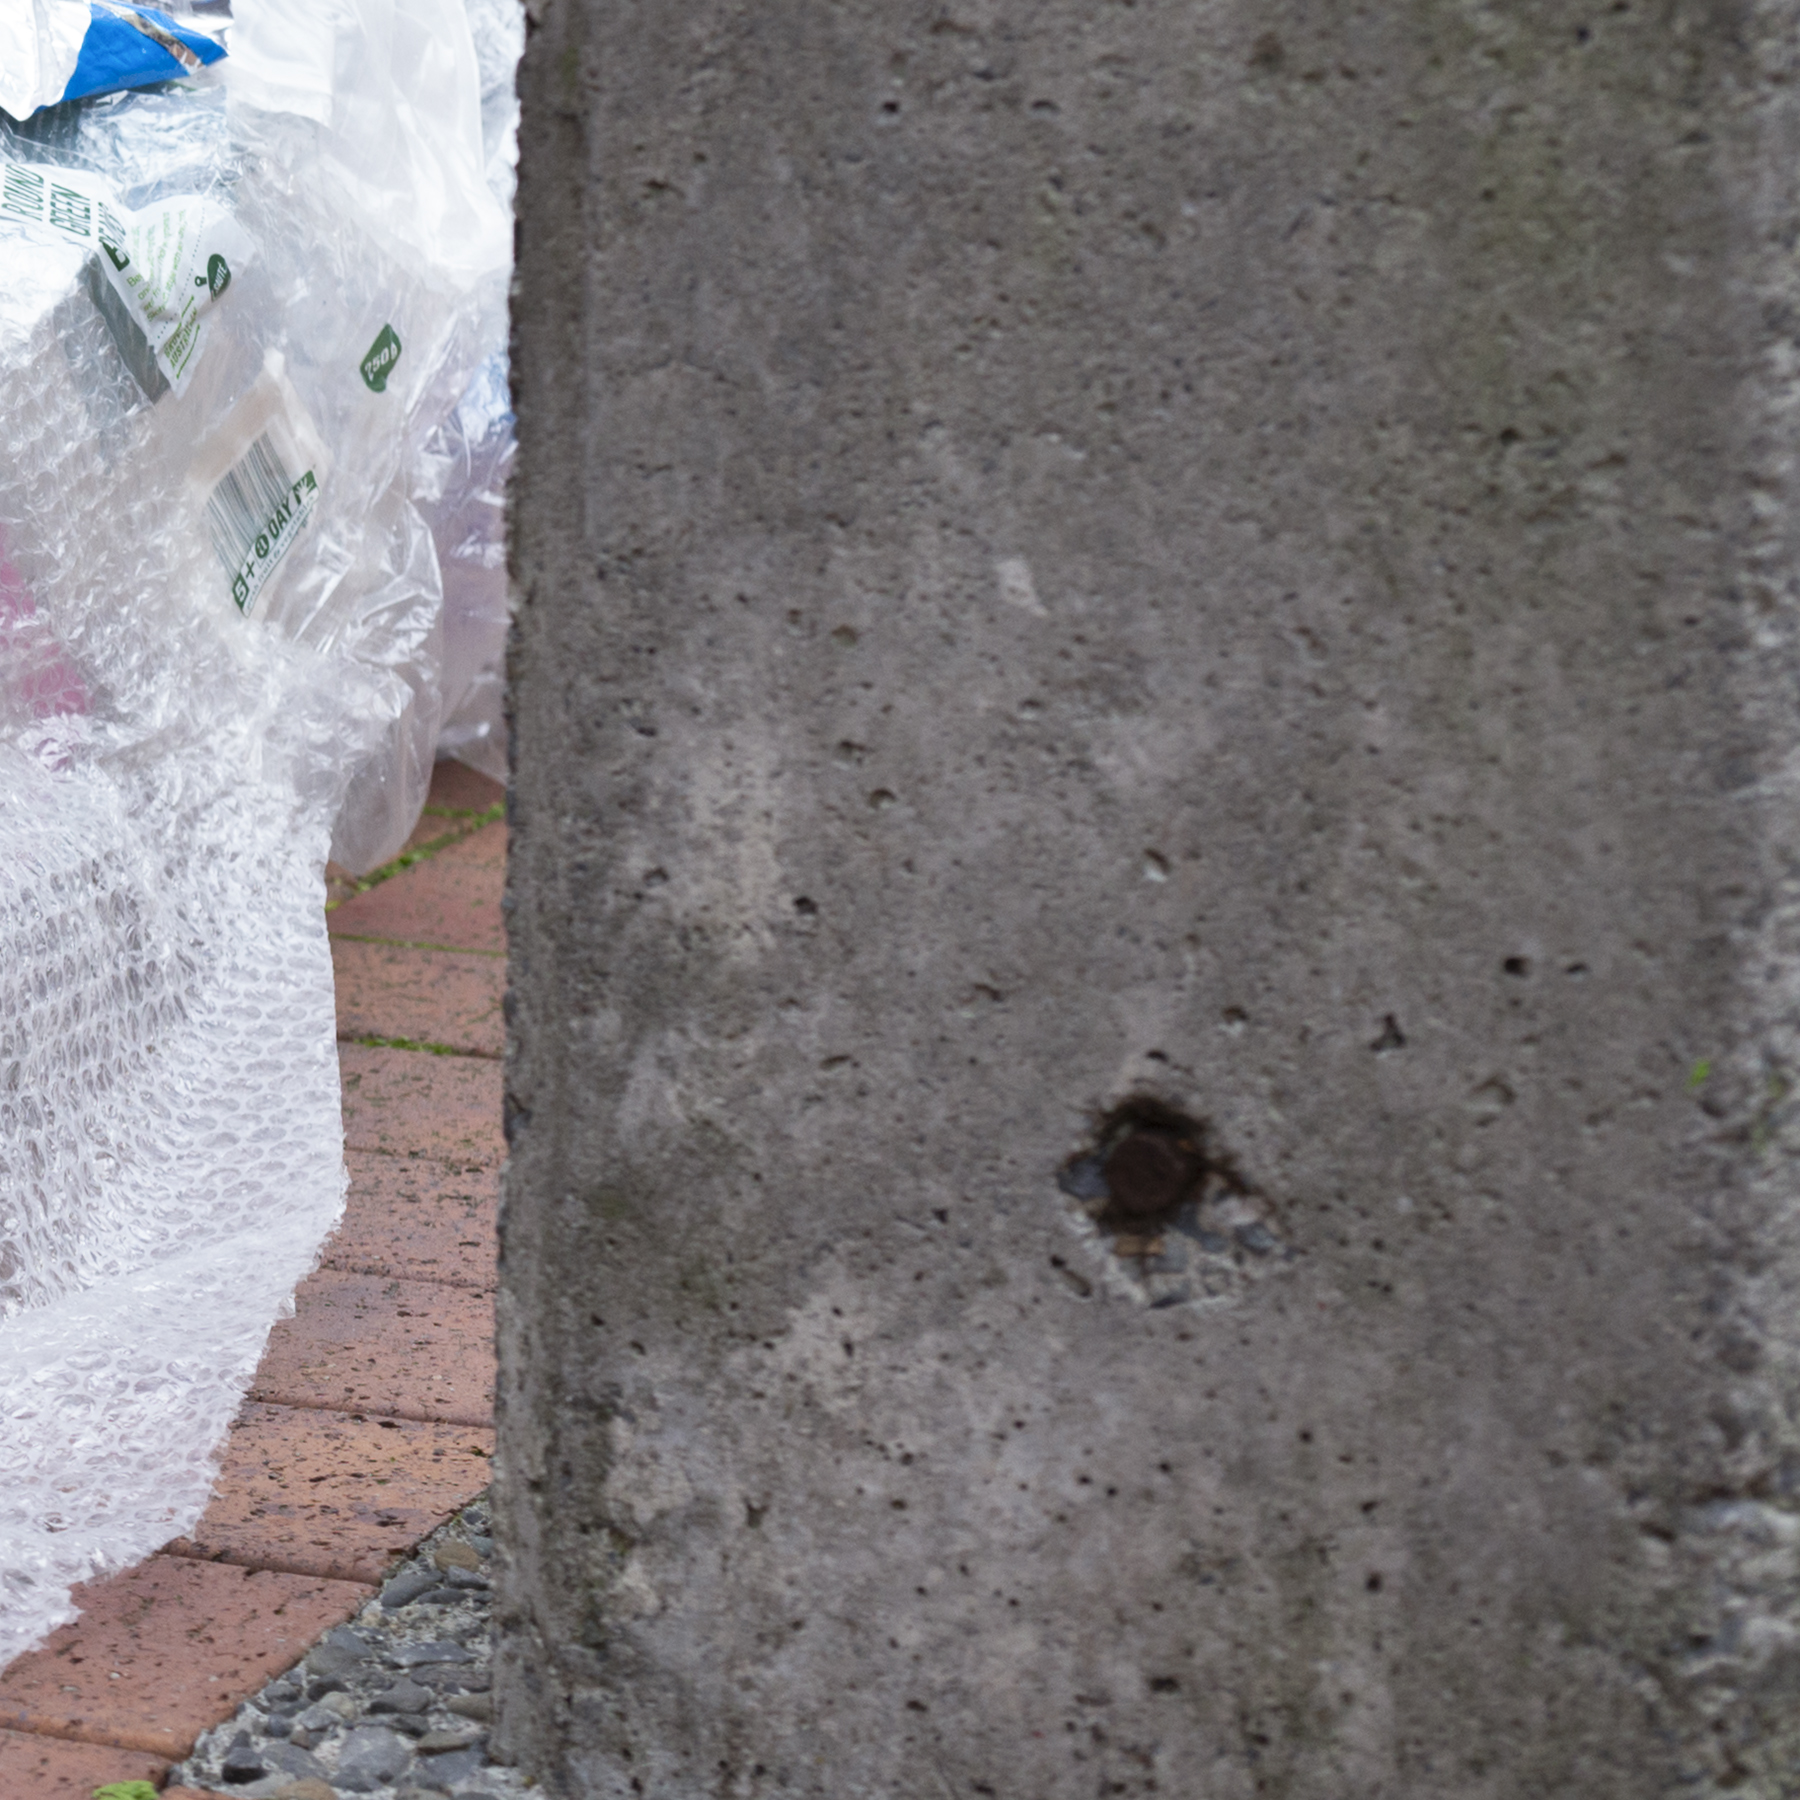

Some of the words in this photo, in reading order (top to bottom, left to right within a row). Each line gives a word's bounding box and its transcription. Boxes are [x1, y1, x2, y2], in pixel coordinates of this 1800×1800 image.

[49, 182, 90, 238] GREEN
[362, 340, 400, 382] 250g
[265, 498, 296, 540] DAY
[254, 557, 275, 583] fruit
